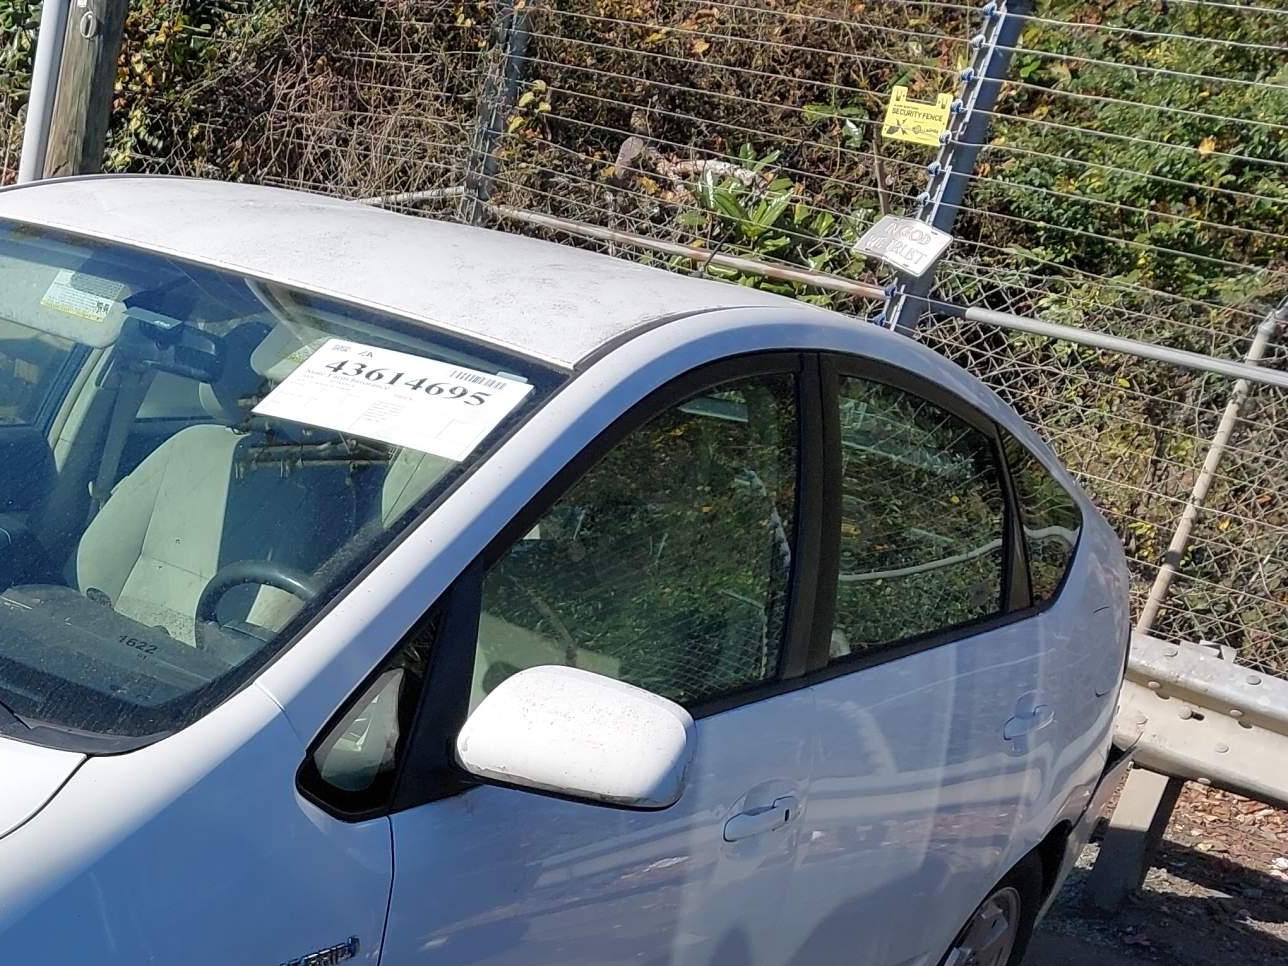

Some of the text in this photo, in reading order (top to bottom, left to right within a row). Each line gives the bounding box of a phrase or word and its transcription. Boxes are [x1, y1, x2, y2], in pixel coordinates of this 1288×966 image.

[891, 107, 922, 120] SECURITY
[922, 112, 943, 122] FENCE
[900, 225, 932, 246] GOD
[324, 359, 492, 407] 43614695
[119, 635, 158, 654] 1622
